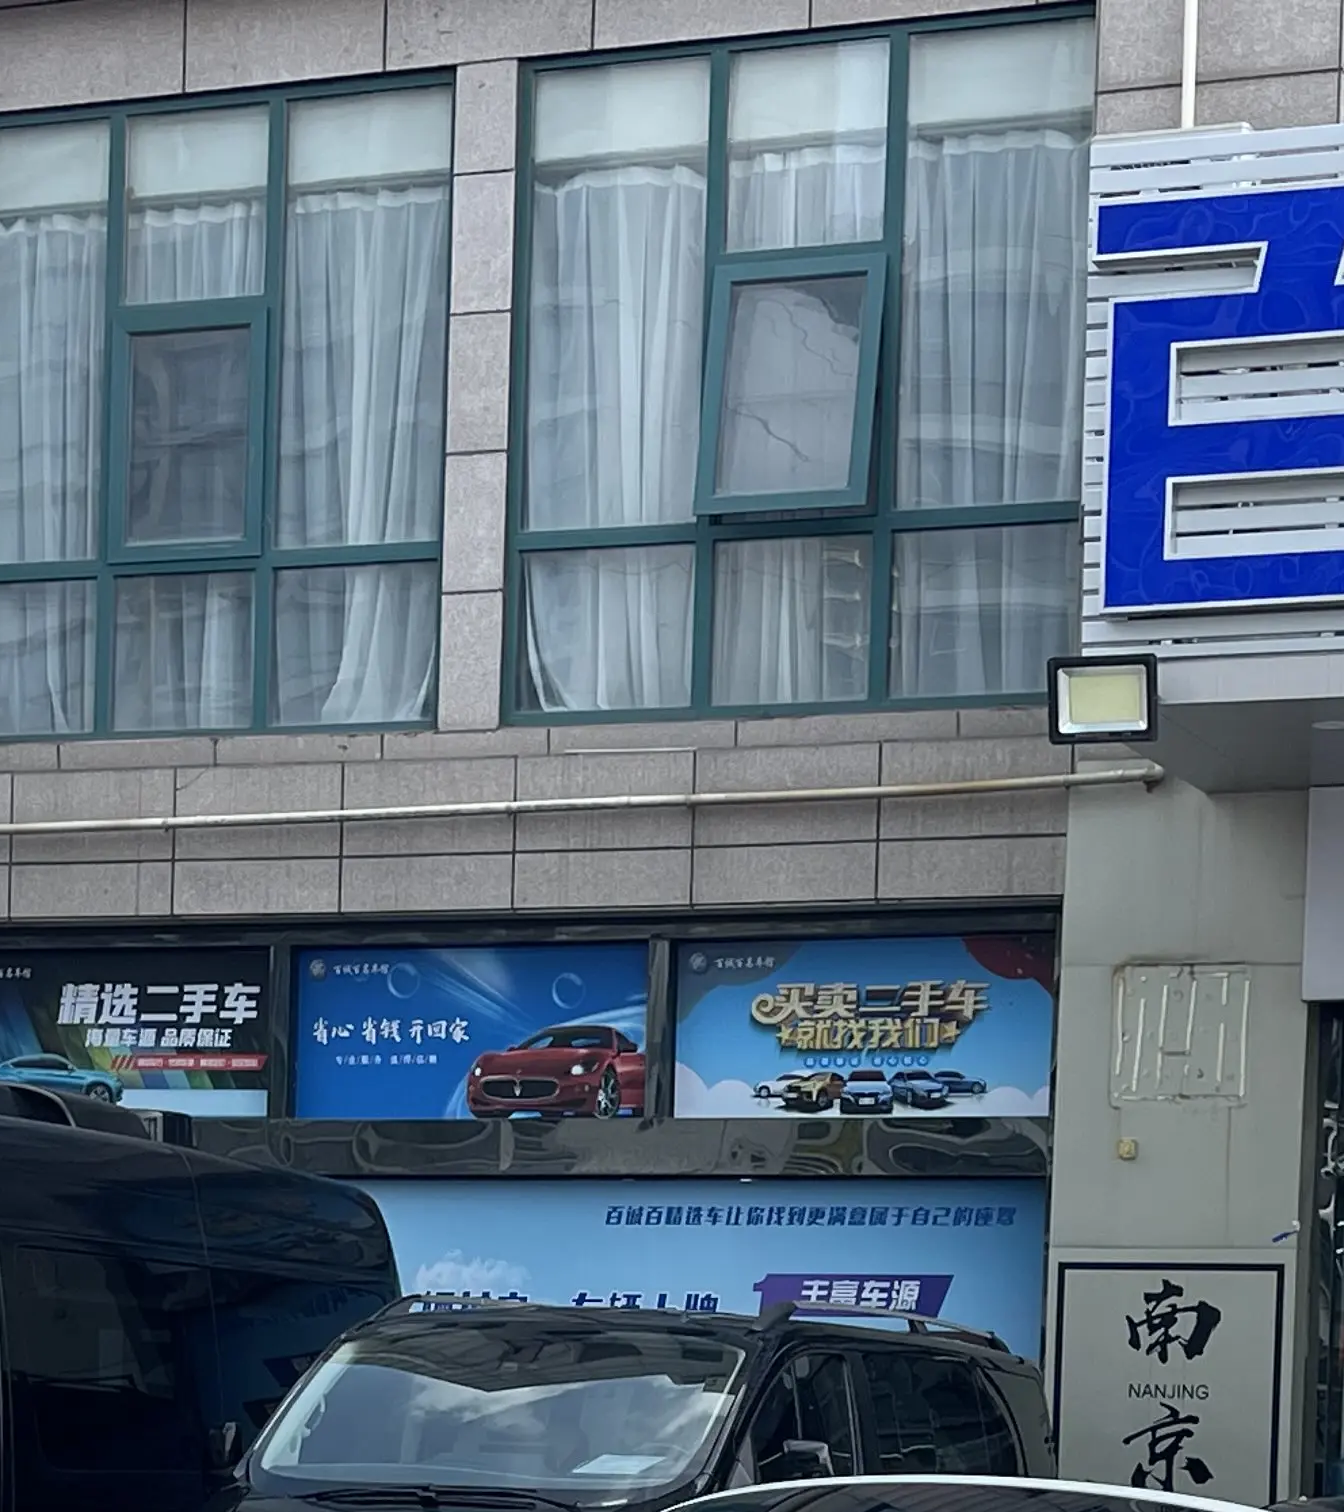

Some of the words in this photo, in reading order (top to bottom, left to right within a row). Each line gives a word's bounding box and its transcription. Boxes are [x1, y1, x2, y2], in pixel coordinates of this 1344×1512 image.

[57, 982, 261, 1025] 精选二手车
[753, 979, 992, 1024] 买卖二手车
[159, 1027, 234, 1048] 品质保证
[312, 1017, 355, 1045] 省心
[408, 1017, 470, 1044] 开回家
[795, 1017, 941, 1050] 就找我们
[800, 1279, 921, 1311] 丰富车源
[1125, 1278, 1222, 1364] 南
[1128, 1383, 1210, 1400] NANJING
[1121, 1402, 1215, 1492] 京
